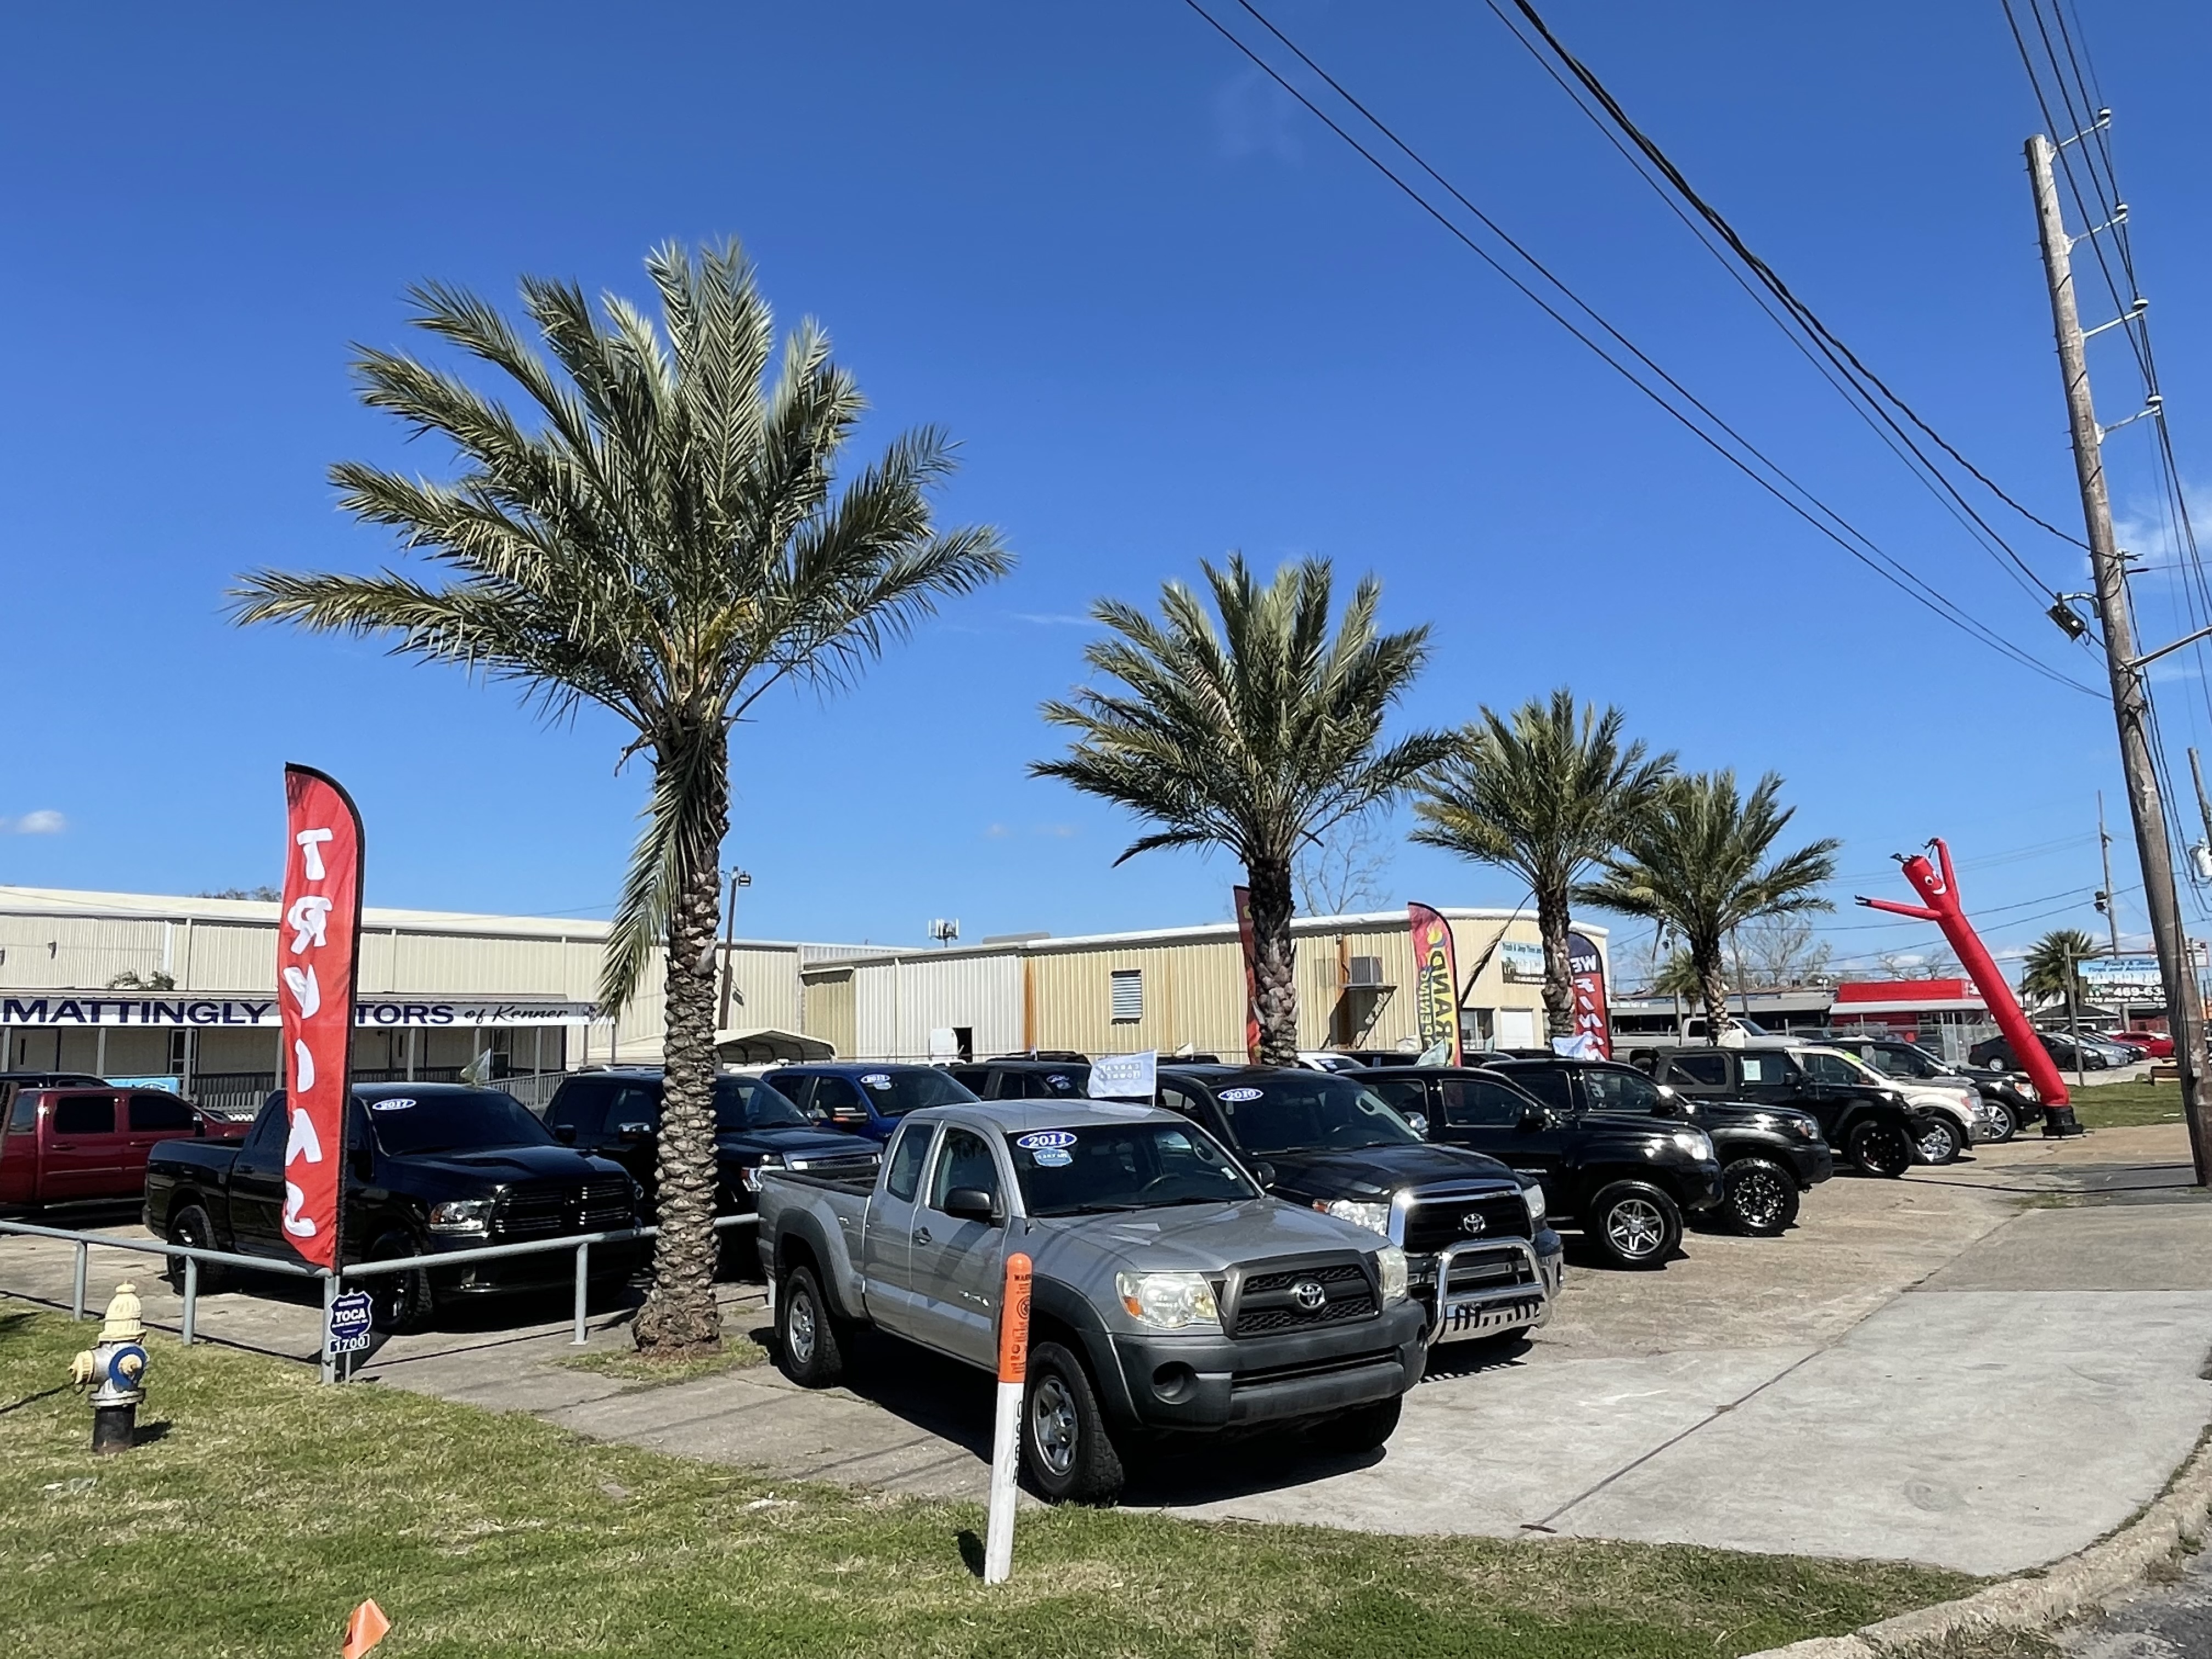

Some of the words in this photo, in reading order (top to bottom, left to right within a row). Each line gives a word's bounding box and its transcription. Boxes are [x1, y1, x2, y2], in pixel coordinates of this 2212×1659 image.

[3, 1000, 271, 1024] MATTINGLY
[355, 1004, 455, 1024] TORS
[464, 1007, 486, 1024] of
[492, 1005, 569, 1023] Kenner
[1227, 1090, 1256, 1099] 2010
[1028, 1133, 1066, 1147] 2011
[335, 1308, 366, 1323] TOCA
[335, 1337, 366, 1351] 1700
